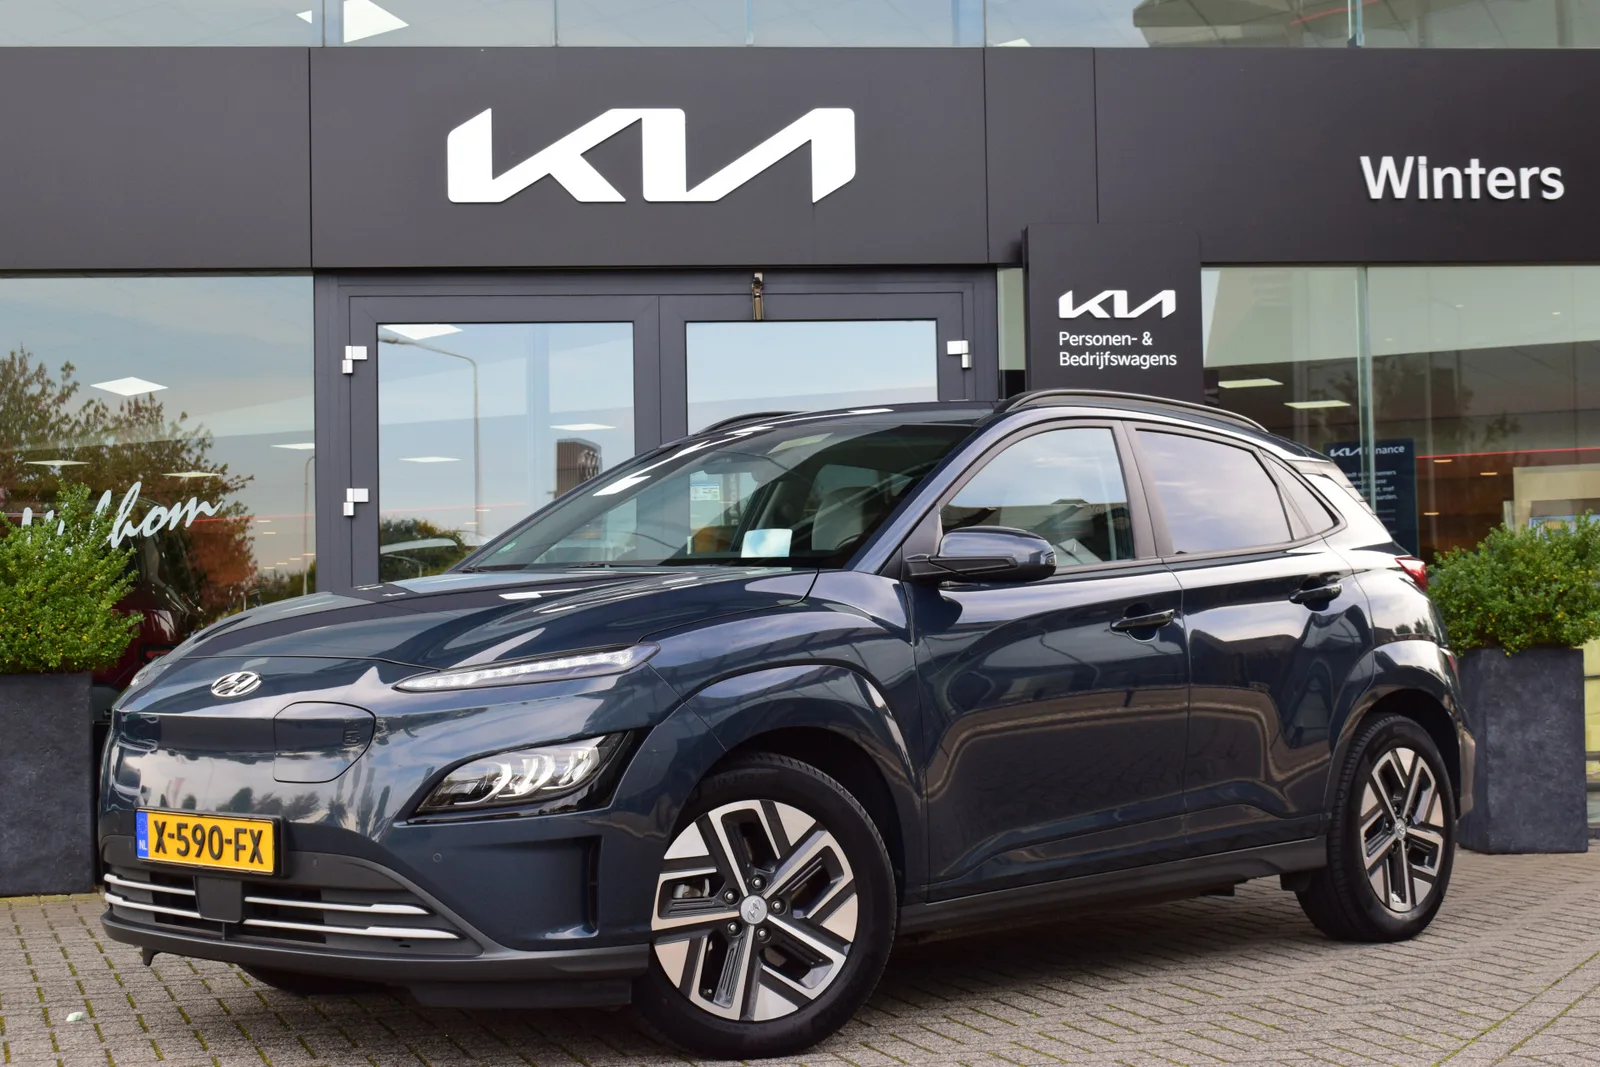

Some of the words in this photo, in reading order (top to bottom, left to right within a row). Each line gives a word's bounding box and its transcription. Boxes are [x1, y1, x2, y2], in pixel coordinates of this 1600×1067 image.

[447, 107, 856, 203] KIA
[1359, 155, 1565, 200] Winters
[1058, 289, 1177, 319] KIA
[1058, 331, 1138, 346] Personen-
[1141, 331, 1153, 346] &
[1059, 351, 1178, 370] Bedrijfswagens
[1364, 445, 1405, 455] nance
[139, 839, 148, 851] NL
[153, 819, 264, 865] X-590-FX
